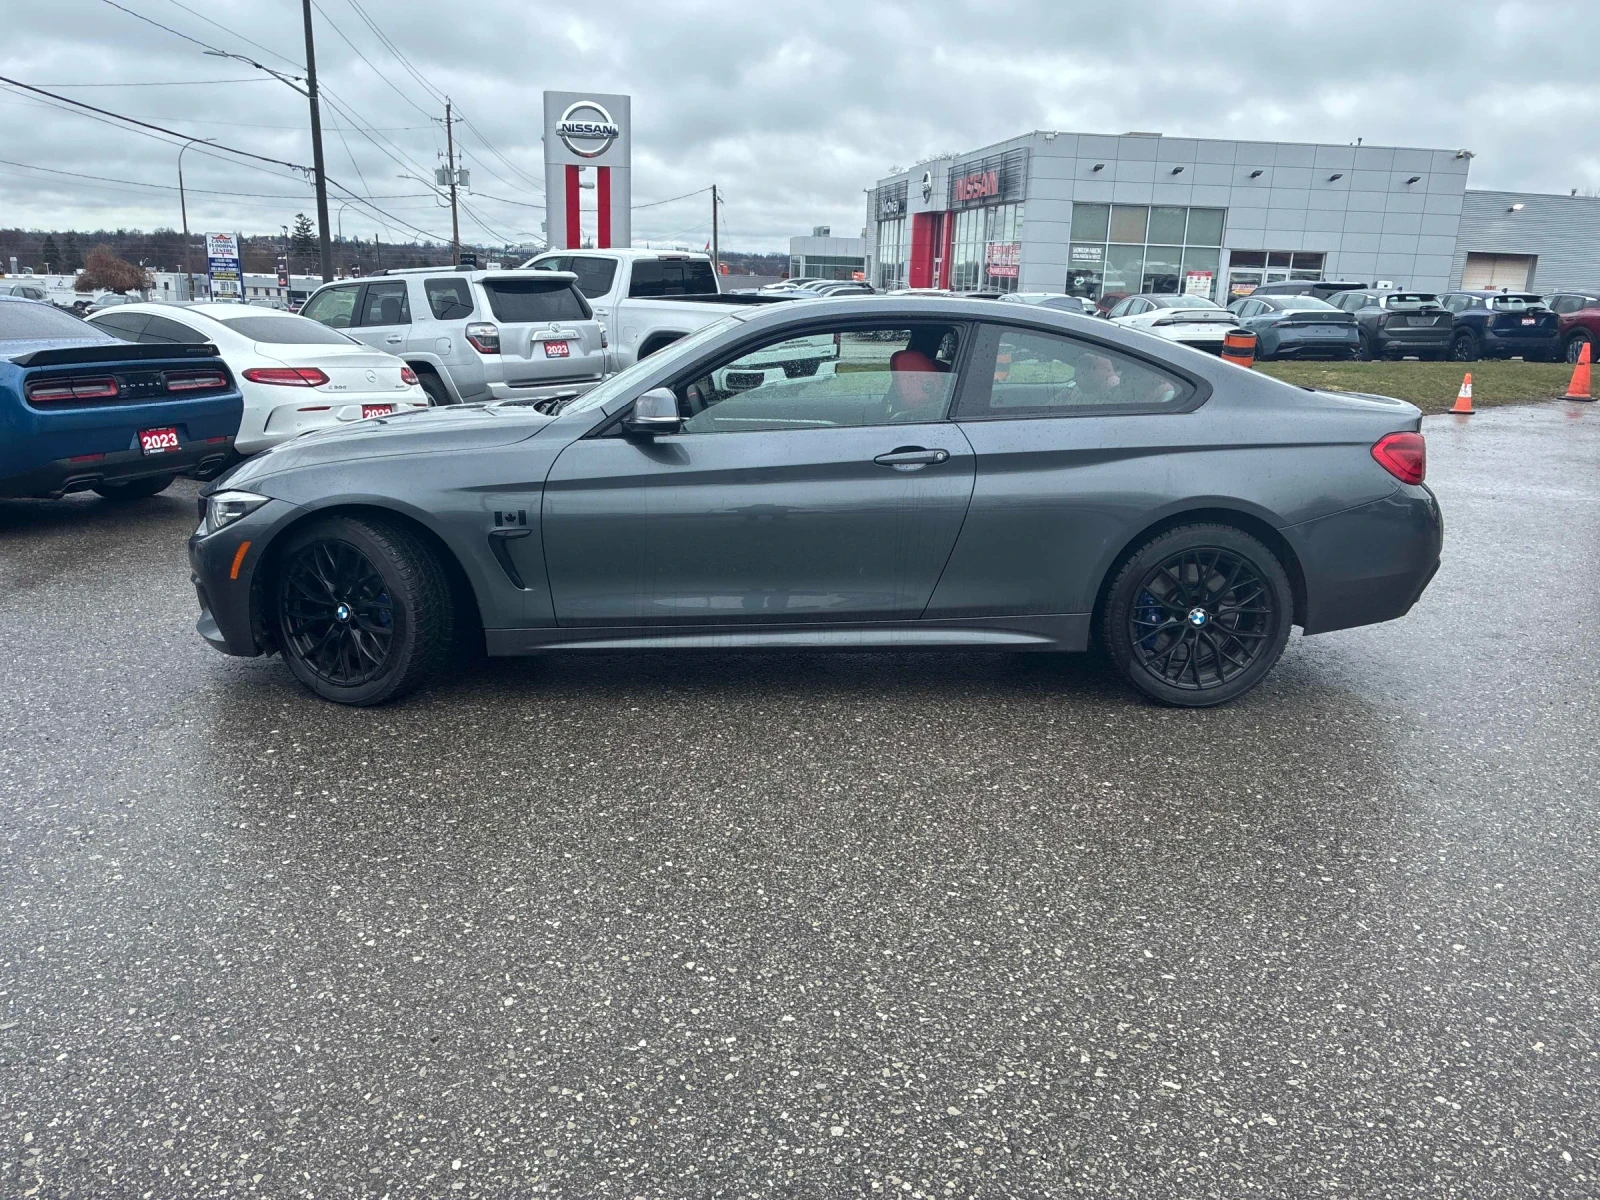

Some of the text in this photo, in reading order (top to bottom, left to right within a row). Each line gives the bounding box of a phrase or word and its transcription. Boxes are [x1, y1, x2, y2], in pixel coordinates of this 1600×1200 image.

[562, 124, 612, 135] NISSAN
[956, 170, 998, 201] NISSAN
[546, 344, 568, 355] 2023
[143, 432, 178, 450] 2023
